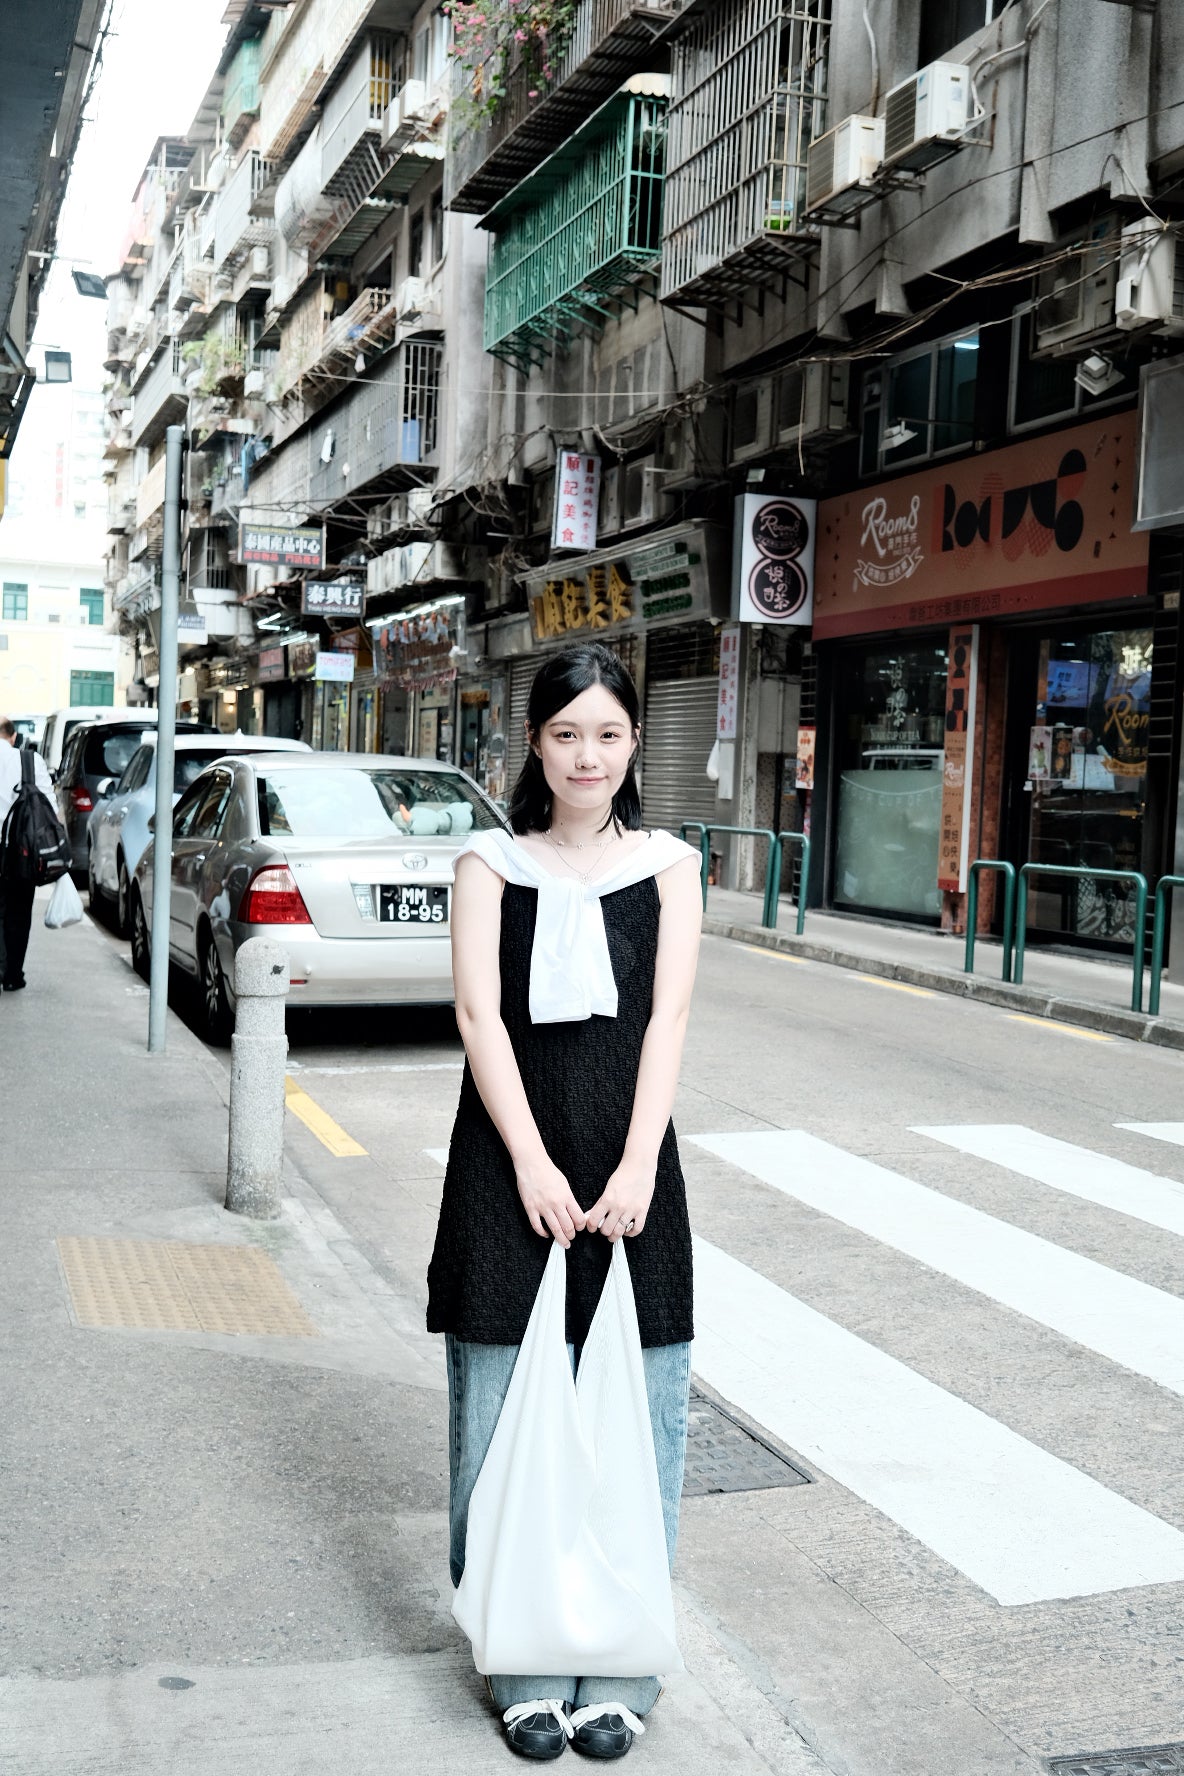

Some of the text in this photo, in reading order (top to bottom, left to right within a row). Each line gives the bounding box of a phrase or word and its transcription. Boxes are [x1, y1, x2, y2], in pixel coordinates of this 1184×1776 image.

[561, 455, 581, 543] 順記美食
[307, 585, 362, 606] 泰興行
[402, 887, 427, 905] MM
[388, 902, 443, 922] 18-95
